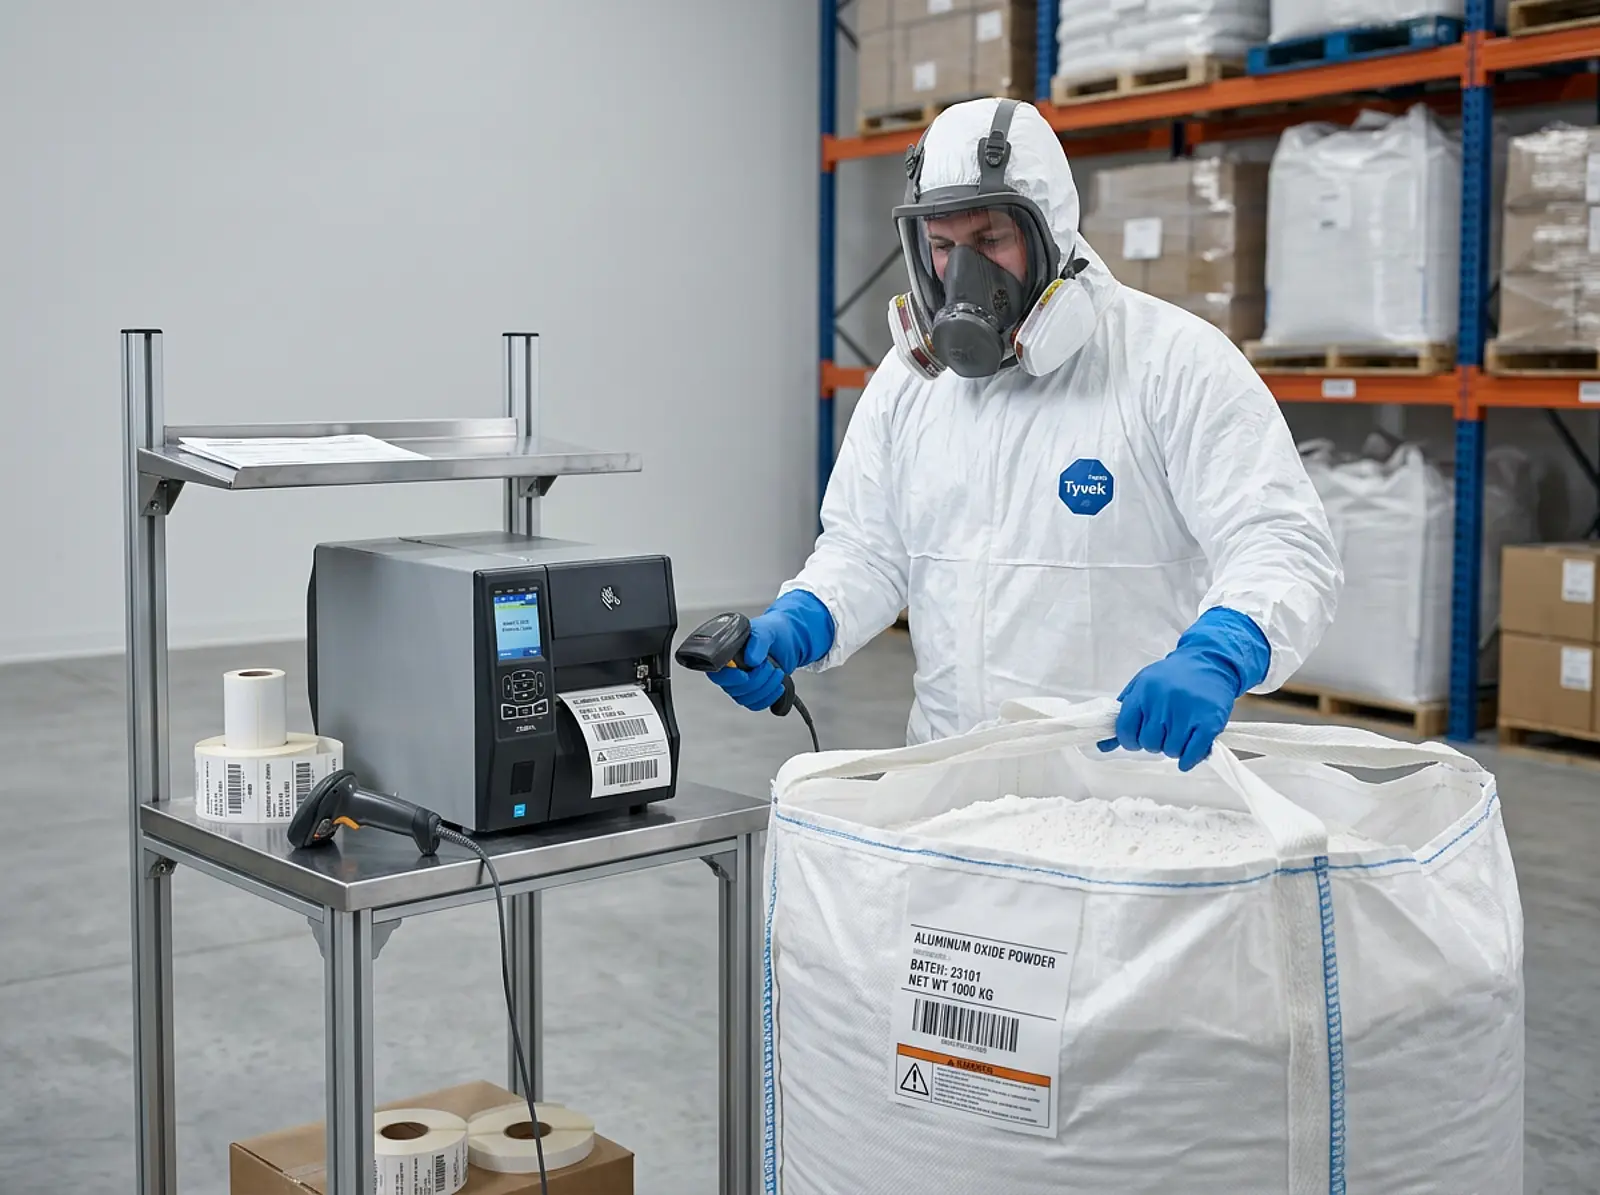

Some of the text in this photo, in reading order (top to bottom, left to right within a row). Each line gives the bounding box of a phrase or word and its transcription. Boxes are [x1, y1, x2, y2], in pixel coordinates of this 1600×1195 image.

[1064, 480, 1106, 497] Tyvek
[914, 932, 971, 953] ALUMINUM
[974, 942, 1006, 960] OXIDE
[1008, 949, 1056, 969] POWDER
[950, 966, 981, 983] 23101
[908, 973, 994, 1001] NET WT 1000 KG
